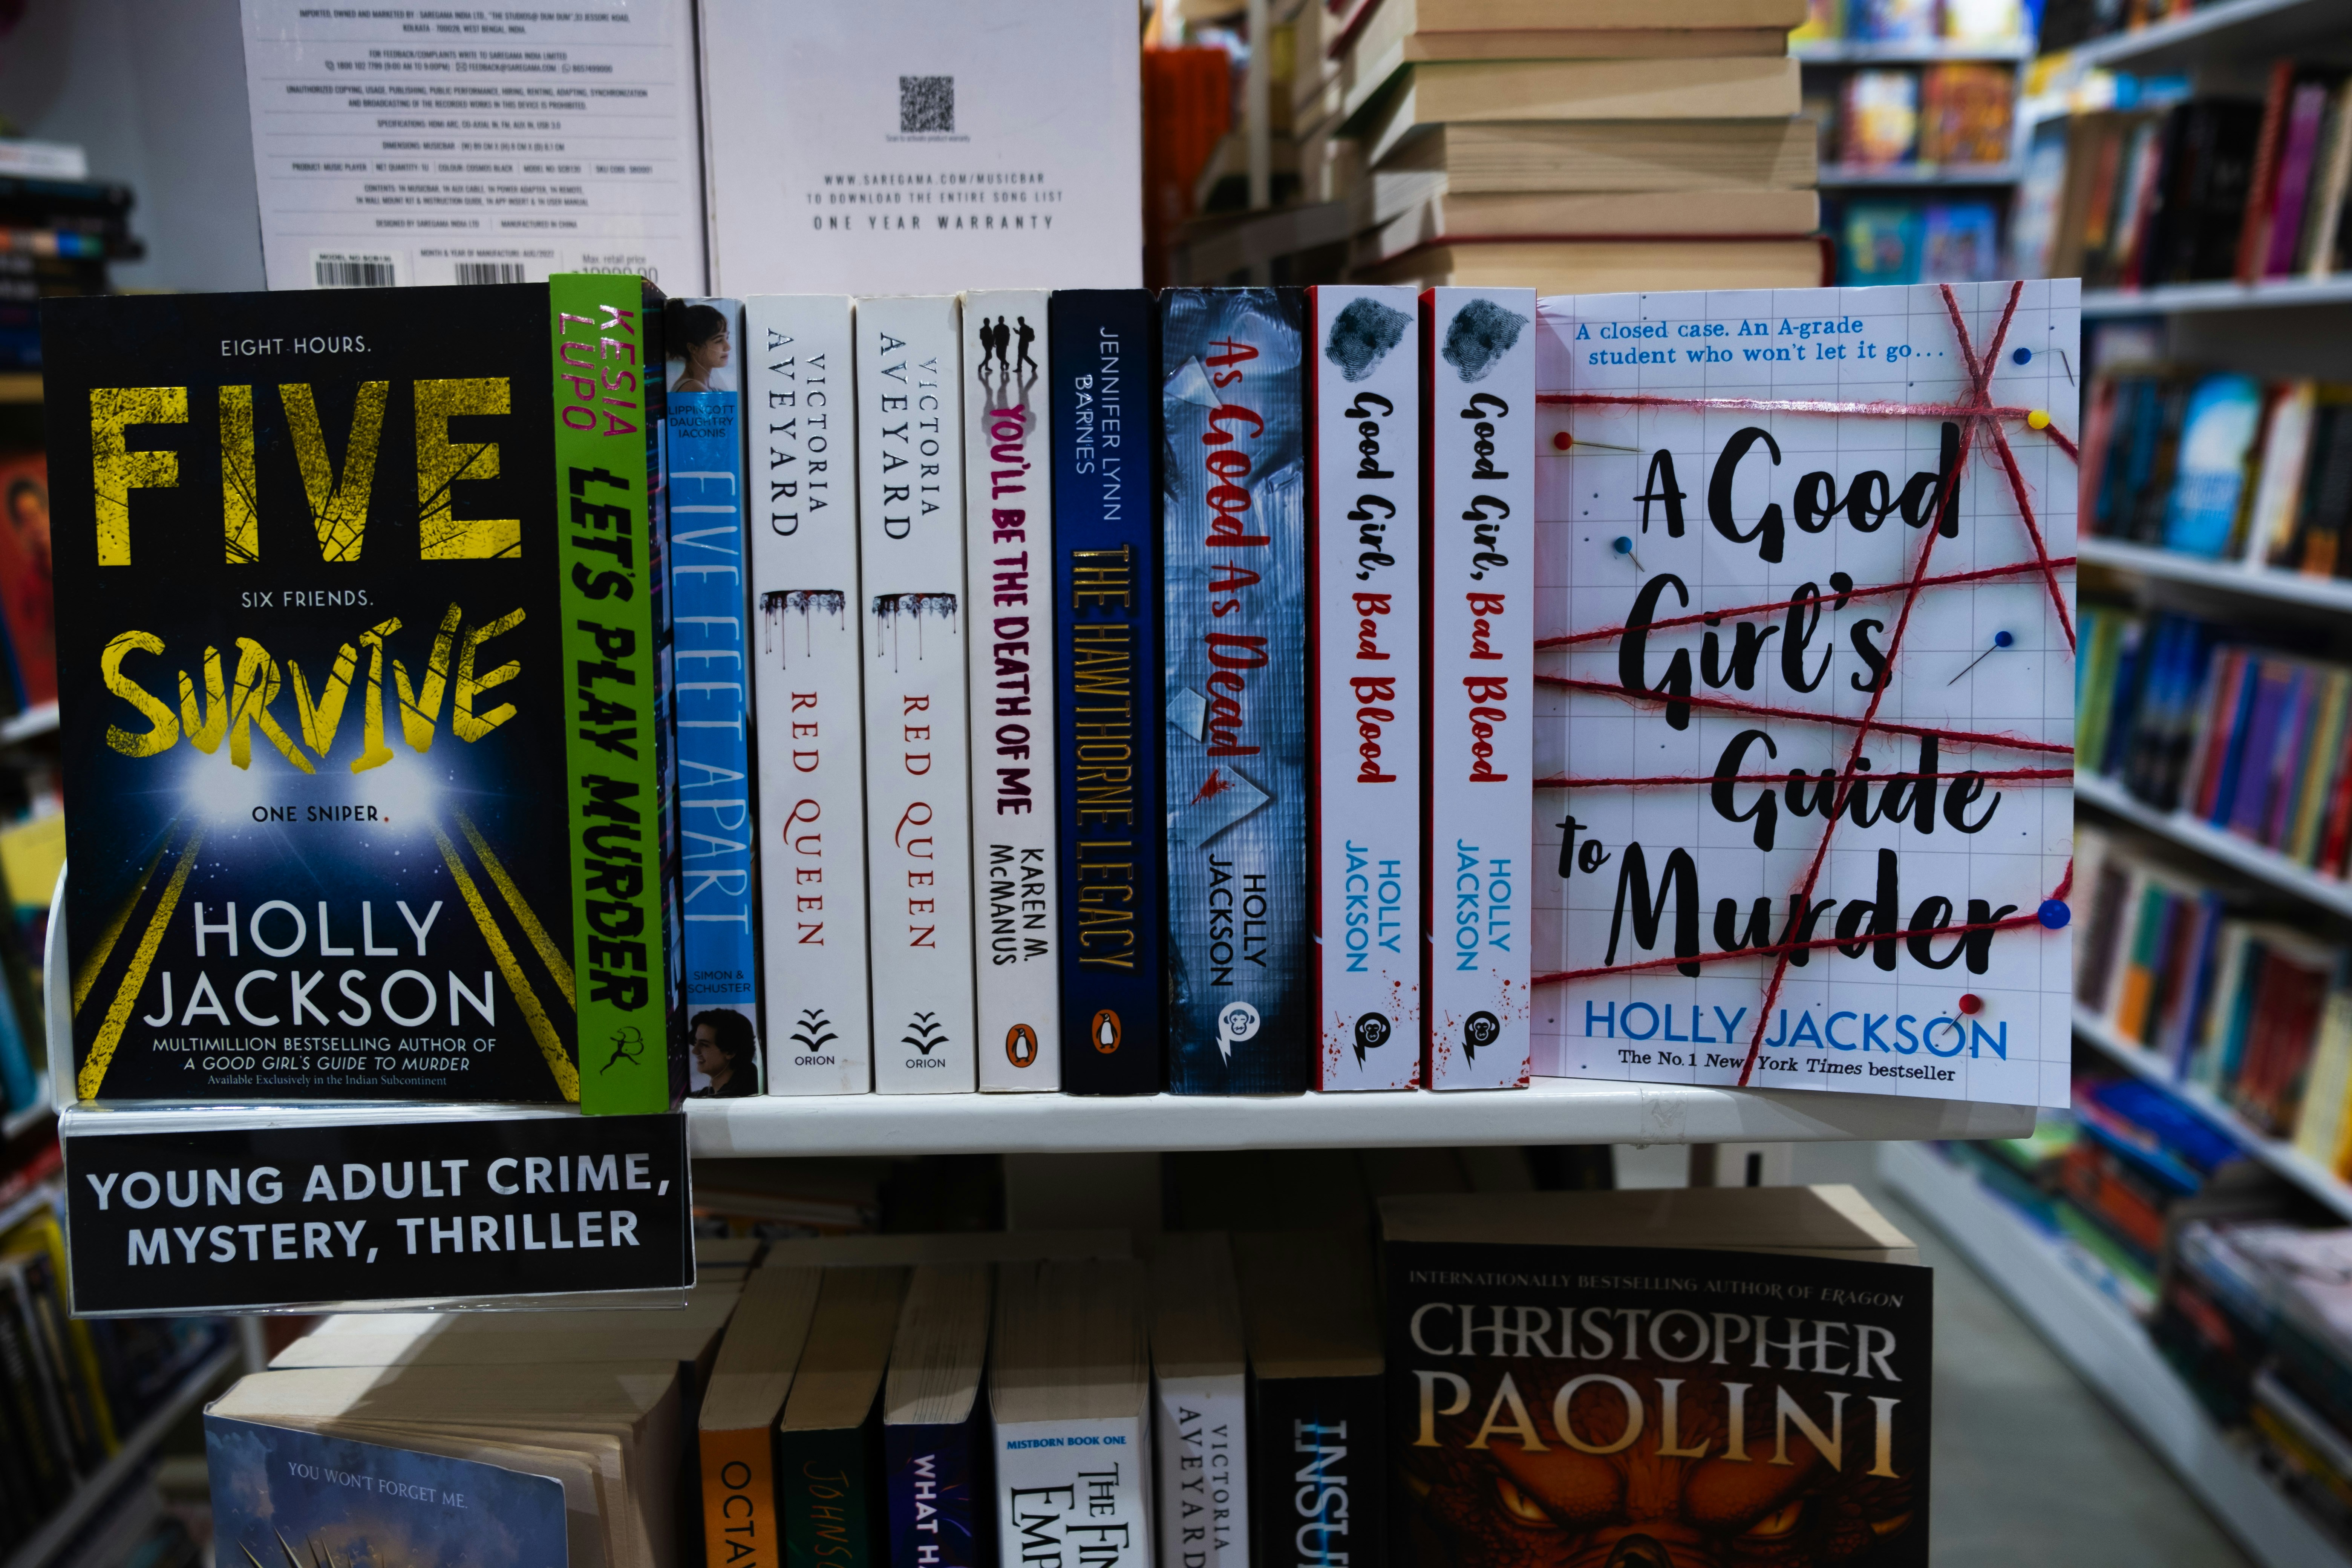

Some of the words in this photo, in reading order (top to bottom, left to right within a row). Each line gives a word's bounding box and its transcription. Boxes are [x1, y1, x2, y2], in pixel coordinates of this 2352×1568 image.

[807, 193, 822, 204] TO
[830, 192, 901, 204] DOWNLOAD
[910, 192, 932, 204] THE
[940, 191, 985, 203] ENTIRE
[993, 191, 1027, 203] SONG
[1035, 191, 1063, 202] LIST
[824, 173, 1044, 186] WWW.SAREGAMA.COM/MUSICBAR
[814, 216, 851, 230] ONE
[869, 216, 920, 230] YEAR
[937, 216, 1052, 229] WARRANTY
[221, 338, 284, 357] EIGHT
[294, 336, 372, 354] HOURS.
[1205, 335, 1259, 389] As
[1576, 323, 1591, 340] A
[1600, 321, 1669, 339] closed
[1677, 323, 1729, 337] case.
[1737, 319, 1769, 336] An
[1778, 316, 1864, 339] A-grade
[1588, 347, 1676, 365] student
[1686, 346, 1733, 363] who
[1743, 343, 1806, 361] won't
[1816, 343, 1847, 360] let
[1857, 340, 1876, 359] it
[559, 312, 597, 431] LUPO
[599, 305, 638, 437] KESIA
[668, 405, 735, 415] LIPPINCOTT
[1099, 326, 1121, 449] JENNIFER
[670, 417, 734, 426] DAUGHTRY
[679, 429, 726, 438] IACONIS
[766, 328, 799, 536] AVEYARD
[805, 353, 828, 513] VICTORIA
[880, 332, 911, 540] AVEYARD
[919, 357, 940, 516] VICTORIA
[989, 404, 1031, 501] YOU'LL
[1074, 374, 1095, 475] BARNES
[1344, 391, 1395, 479] Good
[1460, 392, 1509, 480] Good
[89, 377, 522, 566] FIVE
[1102, 458, 1122, 521] LYNN
[1201, 404, 1271, 548] Good
[1632, 449, 1687, 538] A
[1707, 421, 1961, 564] Good
[569, 466, 636, 602] LET'S
[670, 471, 739, 586] FIVE
[991, 508, 1027, 545] BE
[1347, 494, 1396, 581] Girl,
[1461, 494, 1510, 581] Girl,
[242, 591, 274, 608] SIX
[283, 590, 374, 607] FRIENDS.
[993, 551, 1029, 608] THE
[1073, 544, 1130, 608] THE
[1207, 560, 1261, 618] As
[993, 616, 1032, 717] DEATH
[1352, 592, 1392, 660] Bad
[1465, 592, 1505, 660] Bad
[1618, 571, 1893, 731] Girl's
[101, 602, 526, 775] SURVIVE
[577, 619, 639, 761] PLAY
[674, 616, 743, 741] FEET
[1204, 632, 1269, 757] Dead
[791, 691, 819, 773] RED
[904, 694, 932, 776] RED
[995, 724, 1031, 761] OF
[1074, 623, 1133, 826] HAWTHORNE
[1349, 677, 1397, 783] Blood
[1462, 676, 1509, 783] Blood
[252, 805, 297, 822] ONE
[996, 768, 1033, 816] ME
[1711, 729, 2001, 852] Guide
[679, 759, 749, 935] APART
[783, 798, 824, 947] QUEEN
[895, 801, 936, 949] QUEEN
[1556, 815, 1611, 879] to
[193, 900, 444, 958] HOLLY
[582, 773, 649, 1012] MURDER
[1021, 848, 1046, 930] KAREN
[1076, 841, 1135, 969] LEGACY
[1208, 853, 1234, 987] JACKSON
[1243, 874, 1267, 968] HOLLY
[1345, 839, 1369, 972] JACKSON
[1378, 860, 1401, 954] HOLLY
[1456, 838, 1479, 971] JACKSON
[1488, 859, 1511, 952] HOLLY
[1604, 841, 2018, 978] Murder
[688, 983, 751, 994] SCHUSTER
[694, 971, 732, 980] SIMON
[736, 970, 744, 979] &
[1023, 938, 1049, 962] M.
[143, 969, 495, 1027] JACKSON
[1585, 1000, 1747, 1044] HOLLY
[1765, 1009, 2007, 1061] JACKSON
[153, 1037, 276, 1051] MULTIMILLION
[284, 1037, 391, 1052] BESTSELLING
[398, 1038, 467, 1052] AUTHOR
[473, 1038, 497, 1052] OF
[184, 1058, 195, 1070] A
[202, 1057, 255, 1070] GOOD
[262, 1055, 310, 1070] GIRL'S
[317, 1057, 367, 1070] GUIDE
[374, 1057, 396, 1070] TO
[401, 1057, 470, 1071] MURDER
[208, 1075, 253, 1084] Available
[256, 1075, 311, 1087] Exclusively
[314, 1075, 323, 1084] in
[327, 1075, 342, 1084] the
[346, 1075, 378, 1085] Indian
[381, 1075, 447, 1085] Subcontinent
[795, 1056, 835, 1066] ORION
[905, 1059, 946, 1069] ORION
[1618, 1049, 1651, 1064] The
[1704, 1054, 1745, 1069] New
[1758, 1056, 1799, 1072] York
[1807, 1059, 1862, 1075] Times
[1868, 1062, 1956, 1081] bestseller
[86, 1166, 283, 1210] YOUNG
[302, 1159, 469, 1202] ADULT
[487, 1153, 670, 1196] CRIME,
[128, 1220, 378, 1266] MYSTERY,
[397, 1210, 640, 1254] THRILLER
[1410, 1271, 1571, 1288] INTERNATIONALLY
[1578, 1274, 1698, 1291] BESTSELLING
[1704, 1280, 1783, 1300] AUTHOR
[1788, 1285, 1813, 1298] OF
[1820, 1288, 1904, 1308] ERAGON
[1410, 1302, 1903, 1382] CHRISTOPHER
[1007, 1437, 1064, 1450] MISTBORN
[1067, 1436, 1100, 1447] BOOK
[1103, 1436, 1127, 1446] ONE
[1411, 1369, 1902, 1479] PAOLINI
[288, 1461, 320, 1481] YOU
[324, 1468, 374, 1491] WON'T
[378, 1478, 436, 1503] FORGET
[442, 1491, 468, 1509] ME.
[721, 1461, 756, 1568] OCTA
[914, 1454, 939, 1534] WHAT
[1078, 1462, 1119, 1518] THE
[1179, 1406, 1206, 1568] AVEYARD
[1211, 1424, 1230, 1551] VICTORIA
[1294, 1418, 1349, 1568] INSU
[917, 1545, 940, 1568] H
